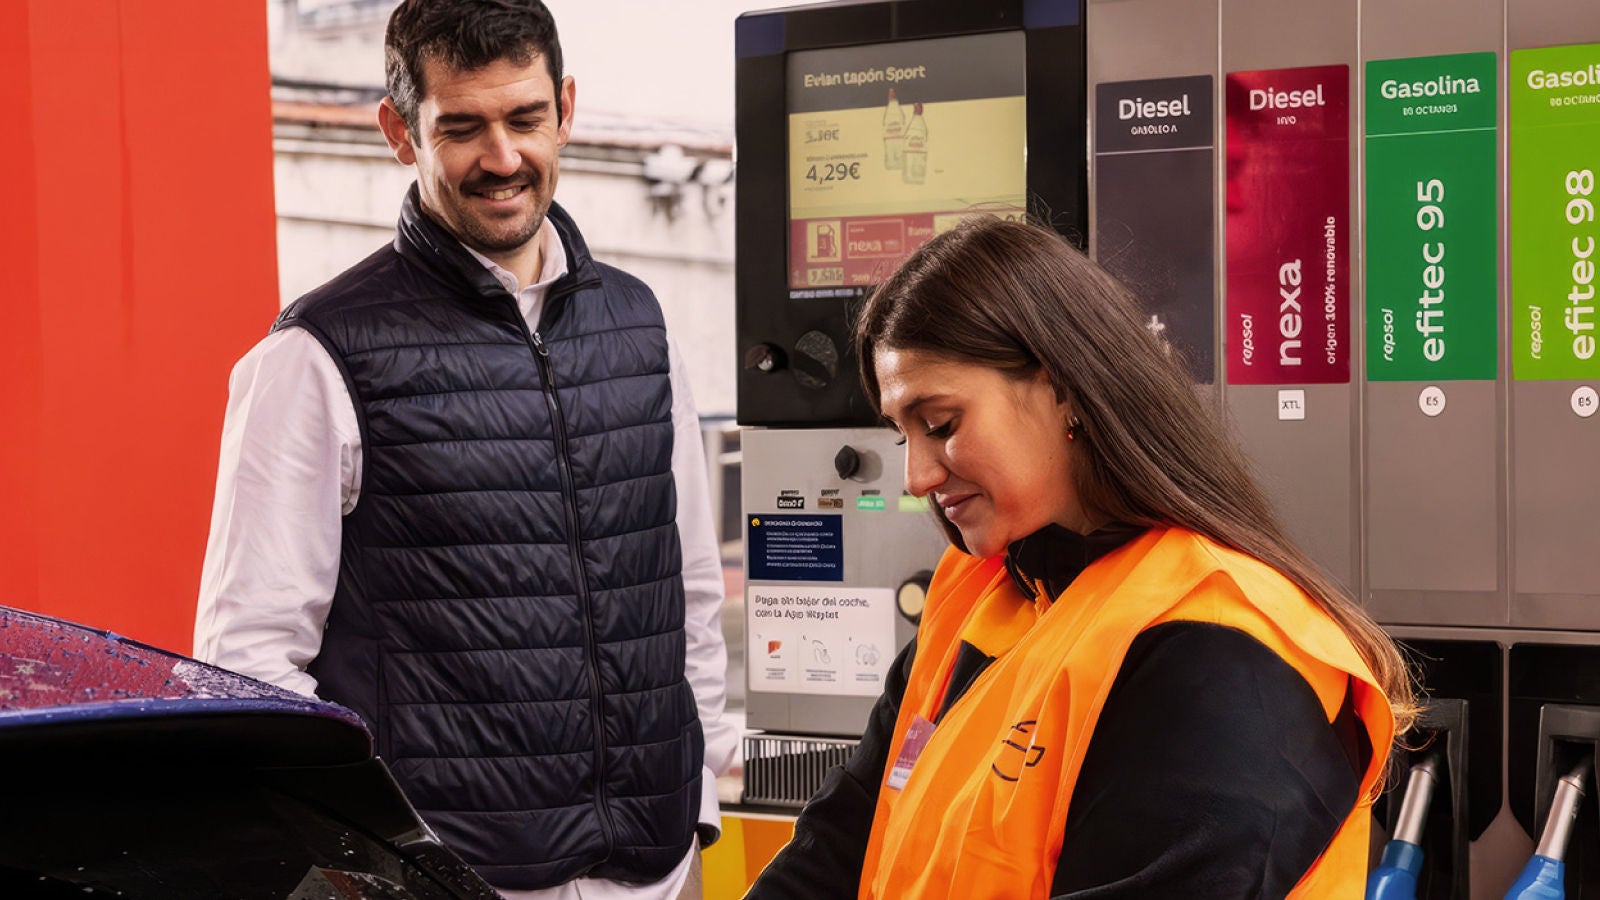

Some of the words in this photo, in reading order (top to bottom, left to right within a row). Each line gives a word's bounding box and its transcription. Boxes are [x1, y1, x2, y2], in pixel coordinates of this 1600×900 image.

[804, 74, 841, 88] Evian
[844, 68, 883, 86] tapón
[886, 65, 926, 84] Sport
[1249, 83, 1325, 111] Diesel
[1381, 75, 1480, 99] Gasolina
[1119, 94, 1191, 120] Diesel
[1171, 124, 1178, 133] A
[806, 162, 861, 184] 4,29€
[1416, 179, 1445, 231] 95
[1565, 169, 1595, 225] 98
[1324, 216, 1336, 282] renovable
[1278, 258, 1302, 366] nexa
[1325, 284, 1336, 321] 100%
[1416, 242, 1445, 362] efitec
[1565, 236, 1596, 360] efitec
[1240, 313, 1255, 366] repsol
[1325, 323, 1338, 364] origen
[1381, 308, 1396, 362] repsol
[1528, 304, 1543, 359] repsol
[1281, 400, 1301, 410] XTL
